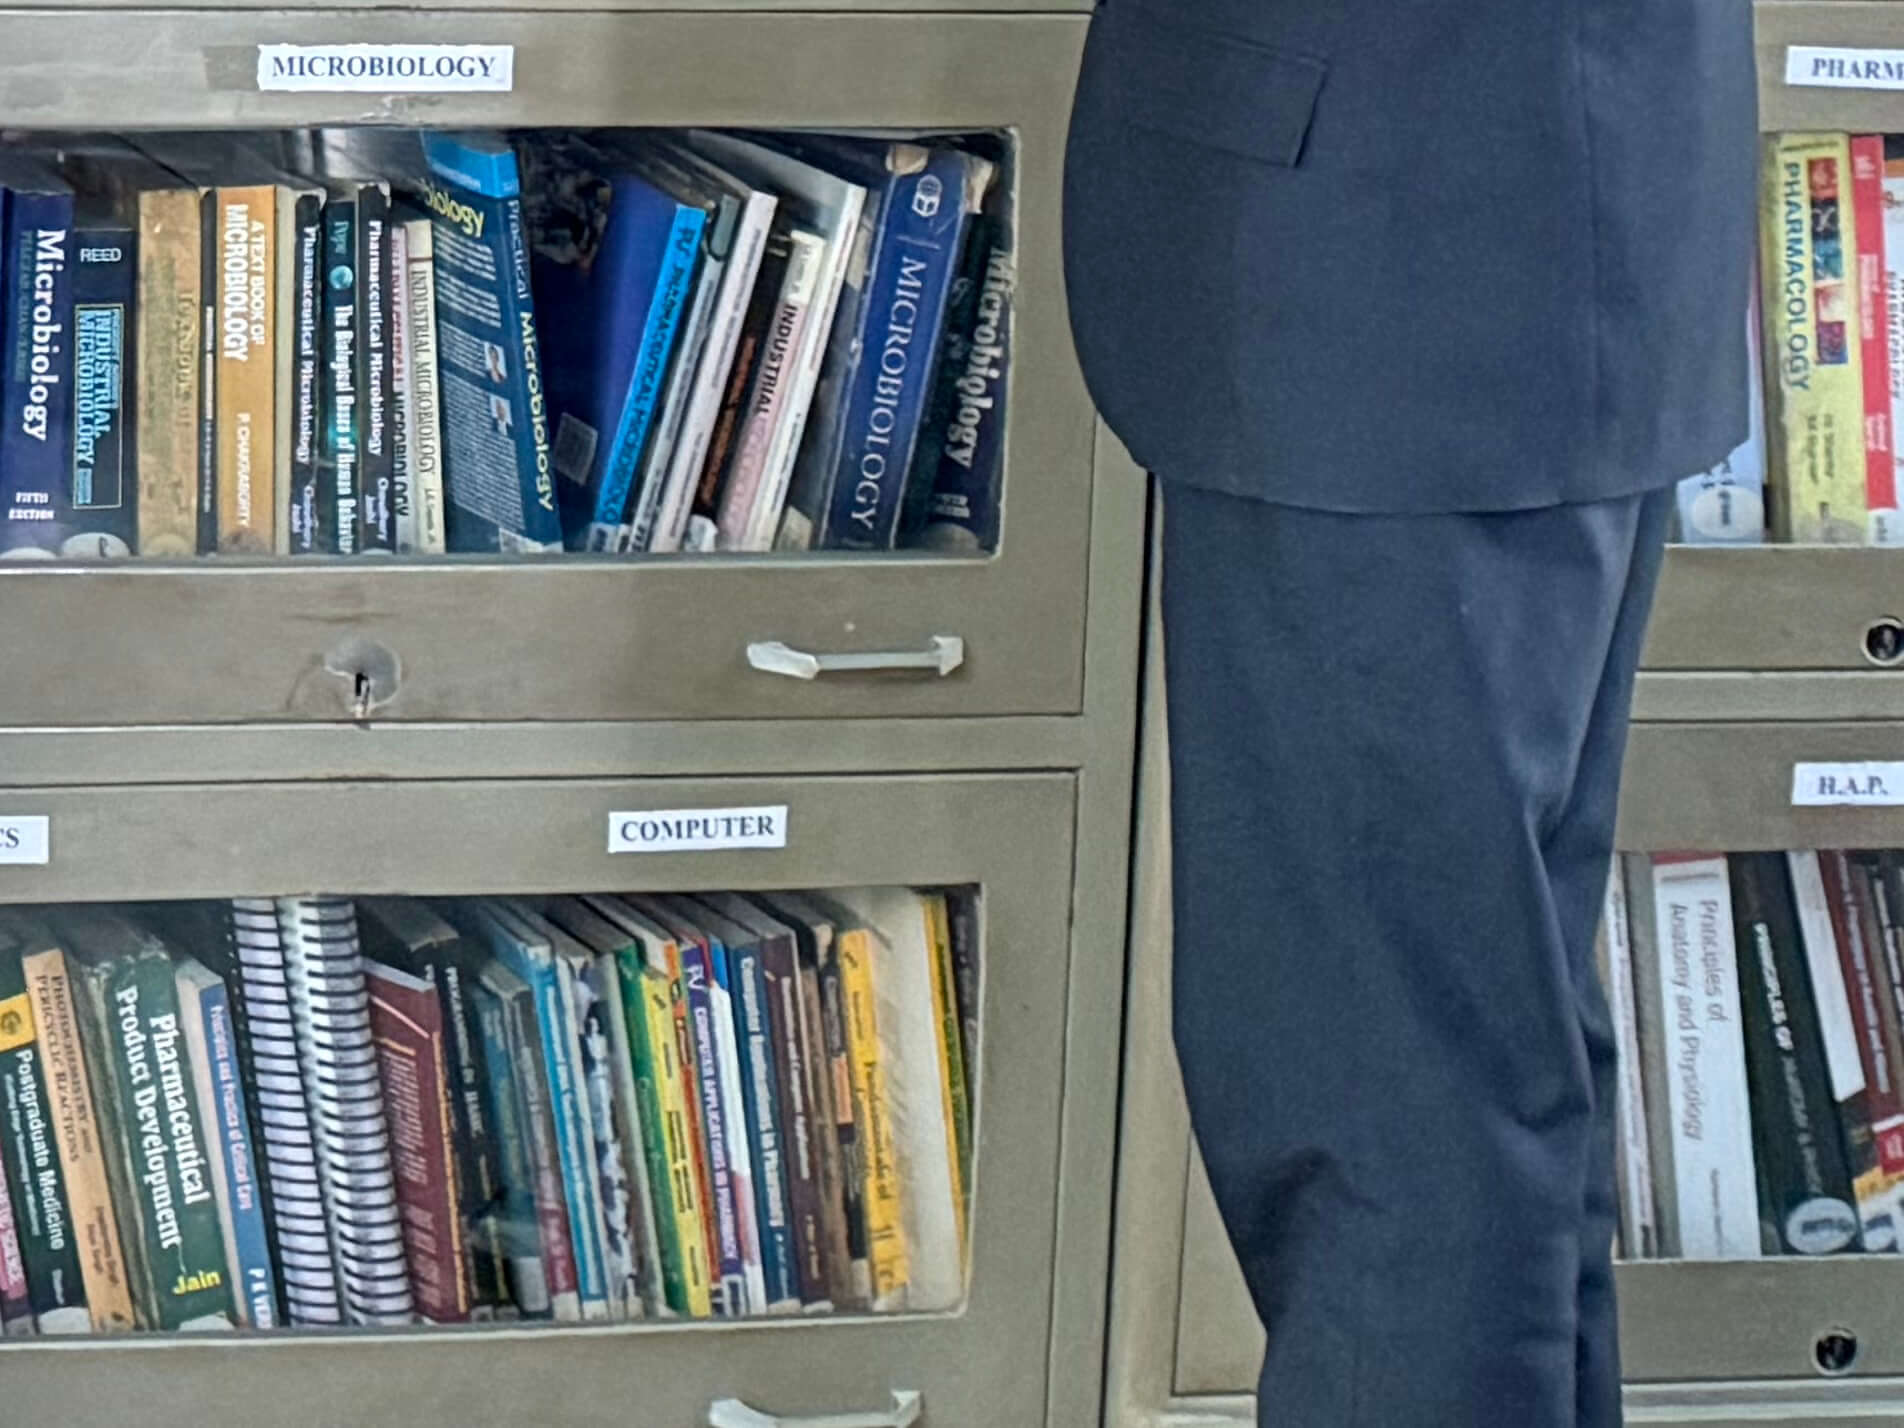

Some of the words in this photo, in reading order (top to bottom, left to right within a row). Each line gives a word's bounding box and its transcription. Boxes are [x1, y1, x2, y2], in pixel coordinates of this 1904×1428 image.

[272, 56, 497, 79] MICROBIOLOGY
[80, 248, 122, 262] REED
[223, 203, 249, 362] MICROBIOLOGY
[250, 276, 265, 322] BOOK
[251, 233, 264, 275] TEXT
[302, 225, 318, 356] Pharmaceutical
[368, 220, 384, 348] Pharmaceutical
[1781, 162, 1810, 391] PHARMACOLOGY
[23, 229, 66, 443] Microbiology
[250, 324, 264, 345] OF
[411, 269, 431, 358] INDUSTRIAL
[507, 199, 529, 299] Practical
[519, 311, 554, 513] Microbiology
[753, 304, 801, 414] INDUSTRIAL
[76, 310, 95, 464] MICROBIOLOGY
[93, 310, 112, 439] INDUSTRIAL
[296, 359, 316, 466] Microbiology
[366, 352, 384, 457] Microbiology
[414, 360, 437, 476] MICROBIOLOGY
[852, 255, 927, 531] MICROBIOLOGY
[620, 816, 775, 843] COMPUTER
[1670, 903, 1693, 988] Anatomy
[1701, 899, 1723, 997] Principles
[1678, 994, 1695, 1031] and
[115, 985, 146, 1083] Product
[133, 1086, 183, 1250] Development
[150, 1013, 210, 1205] Pharmaceutical
[1683, 1035, 1707, 1142] Physiology
[15, 1048, 50, 1167] Postgraduate
[35, 1169, 65, 1252] Medicine
[171, 1269, 221, 1297] Jain
